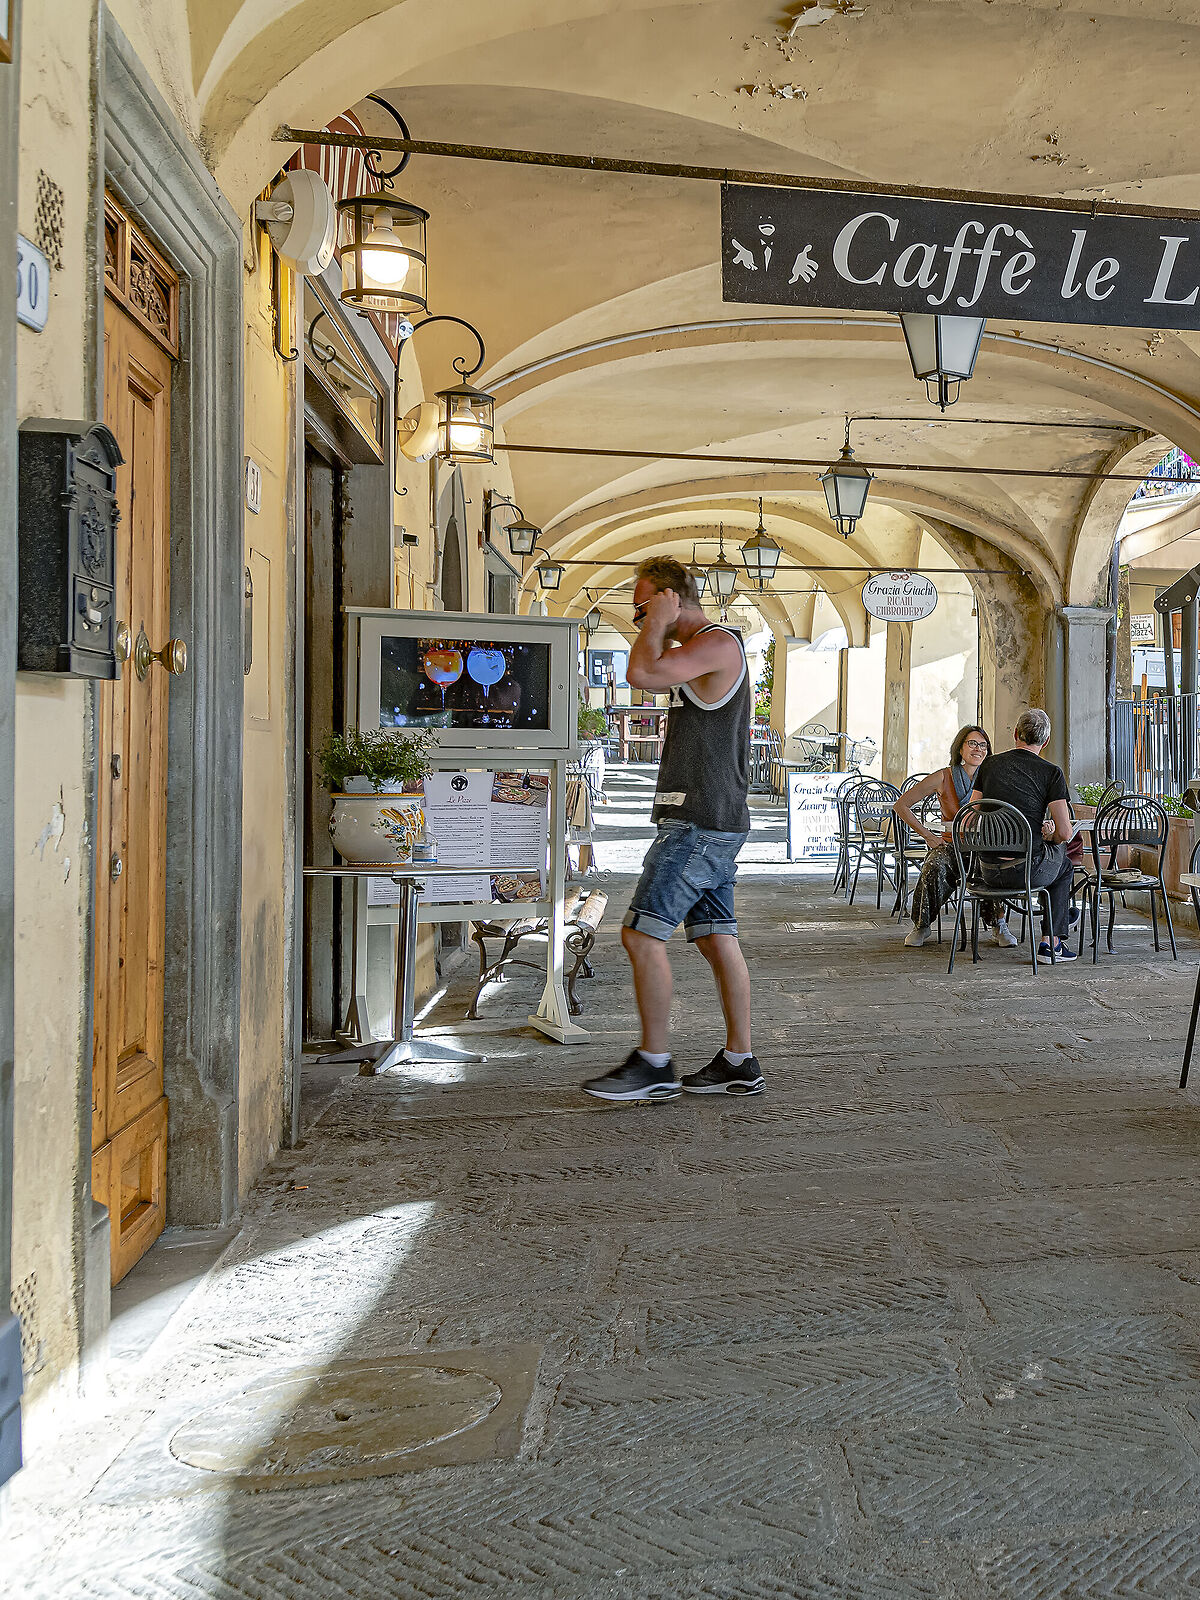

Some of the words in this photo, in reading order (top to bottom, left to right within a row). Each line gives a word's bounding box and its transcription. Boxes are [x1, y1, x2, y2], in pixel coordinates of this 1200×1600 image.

[833, 211, 1036, 308] Caffè
[1060, 229, 1121, 301] le
[867, 580, 900, 595] Grazia
[875, 606, 925, 616] EMBROIDERY
[794, 782, 823, 795] Grazia
